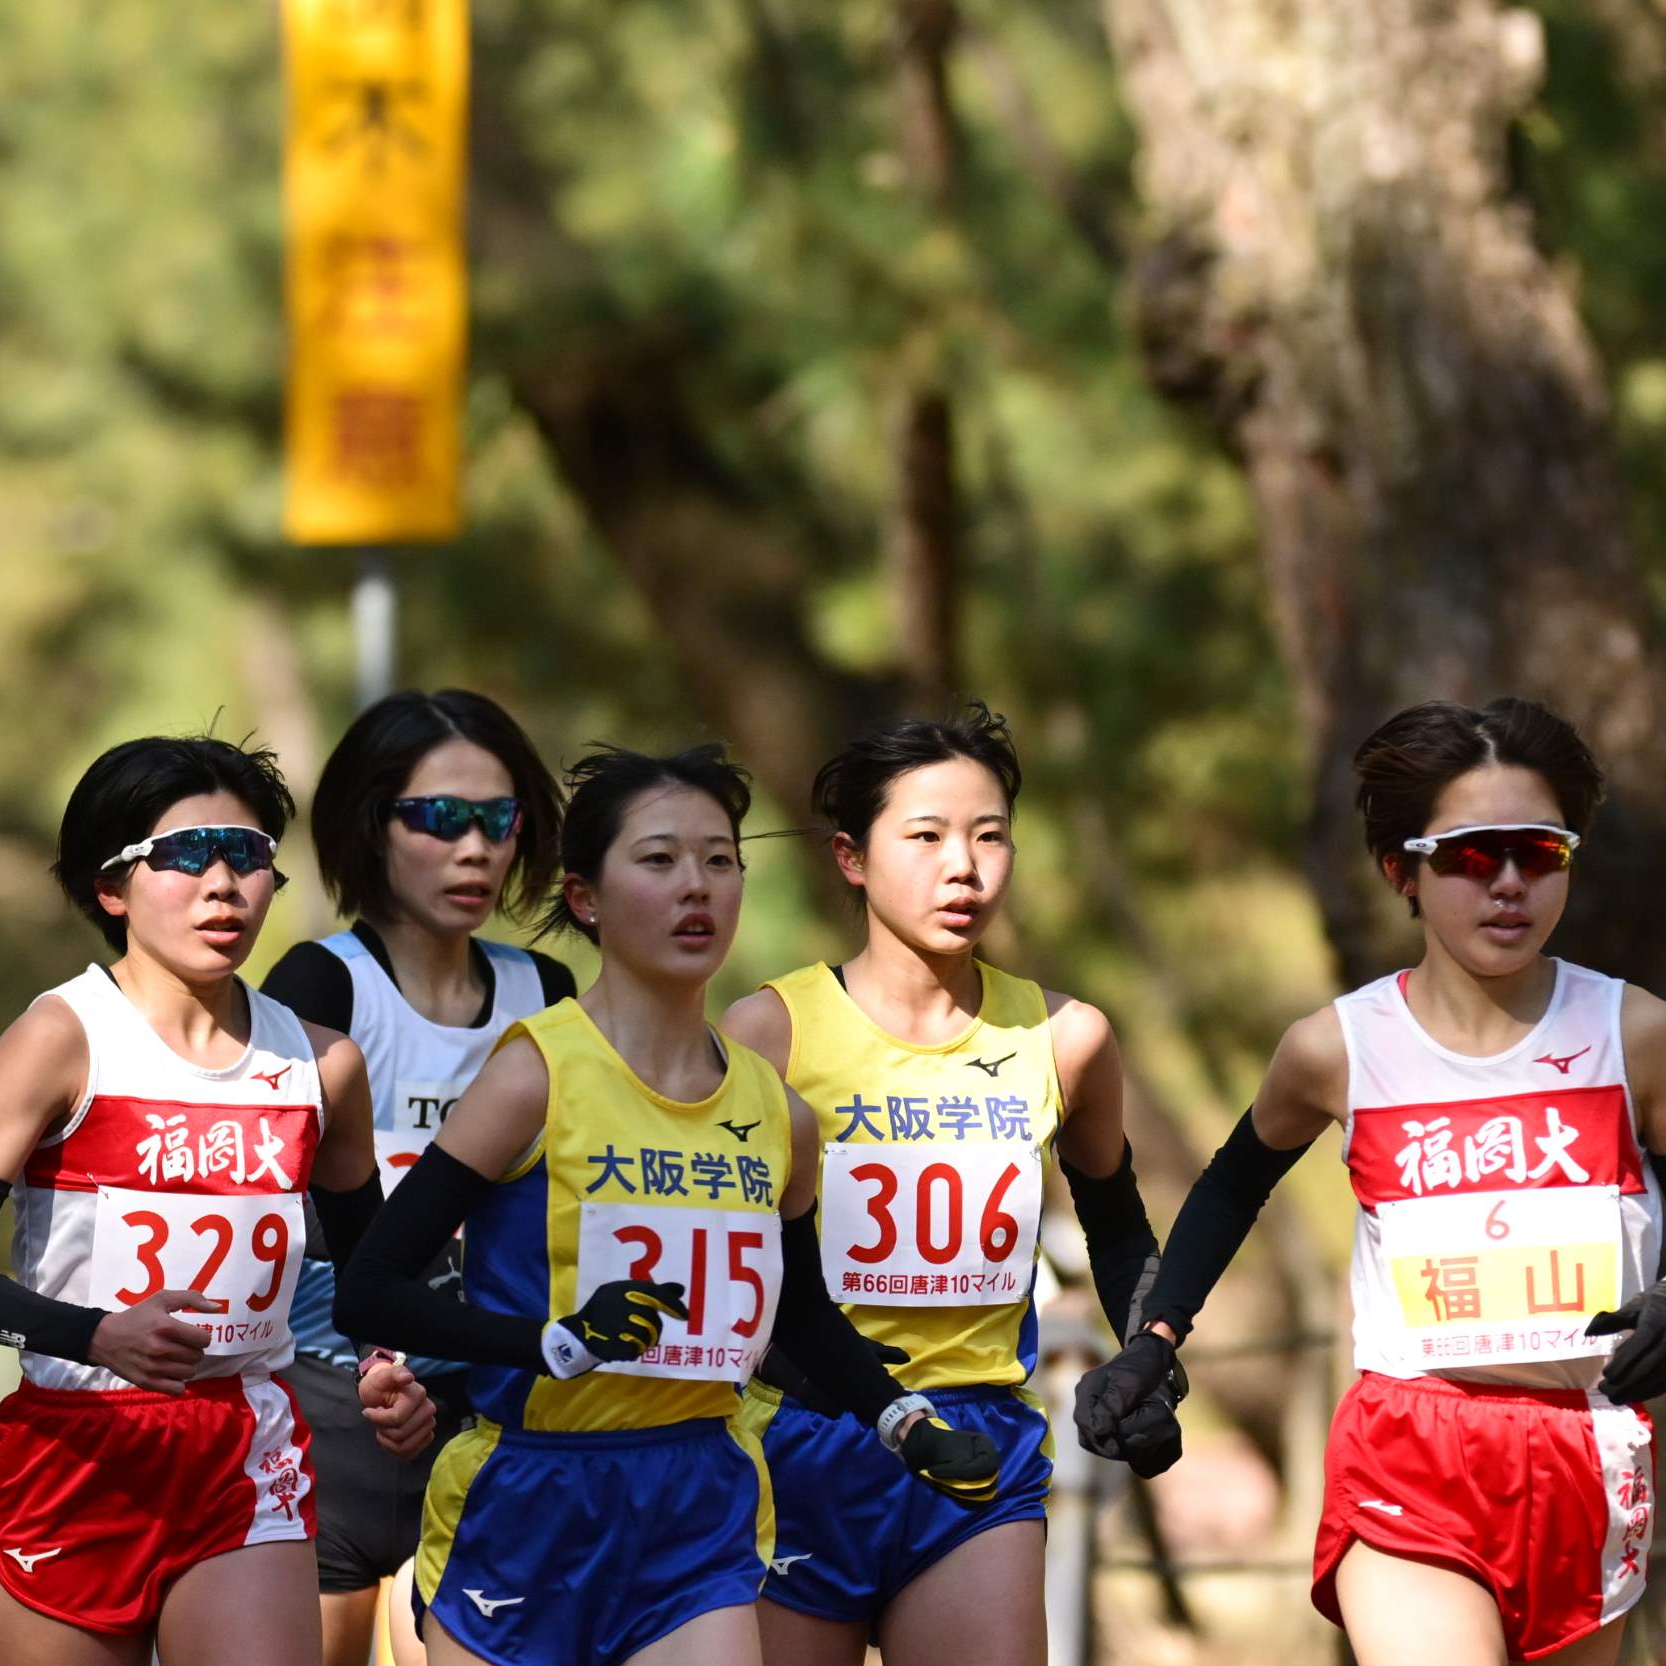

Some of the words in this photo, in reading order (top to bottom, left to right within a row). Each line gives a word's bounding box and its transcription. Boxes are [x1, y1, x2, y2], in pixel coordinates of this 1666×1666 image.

[136, 1114, 294, 1190] 福岡大
[835, 1093, 1033, 1143] 大阪学院
[1395, 1107, 1590, 1196] 福岡大
[585, 1144, 774, 1208] 大阪学院
[846, 1162, 1022, 1265] 306
[1485, 1200, 1510, 1240] 6
[114, 1210, 289, 1315] 329
[612, 1224, 765, 1339] 315
[842, 1271, 1016, 1295] 第66回唐津10マイル
